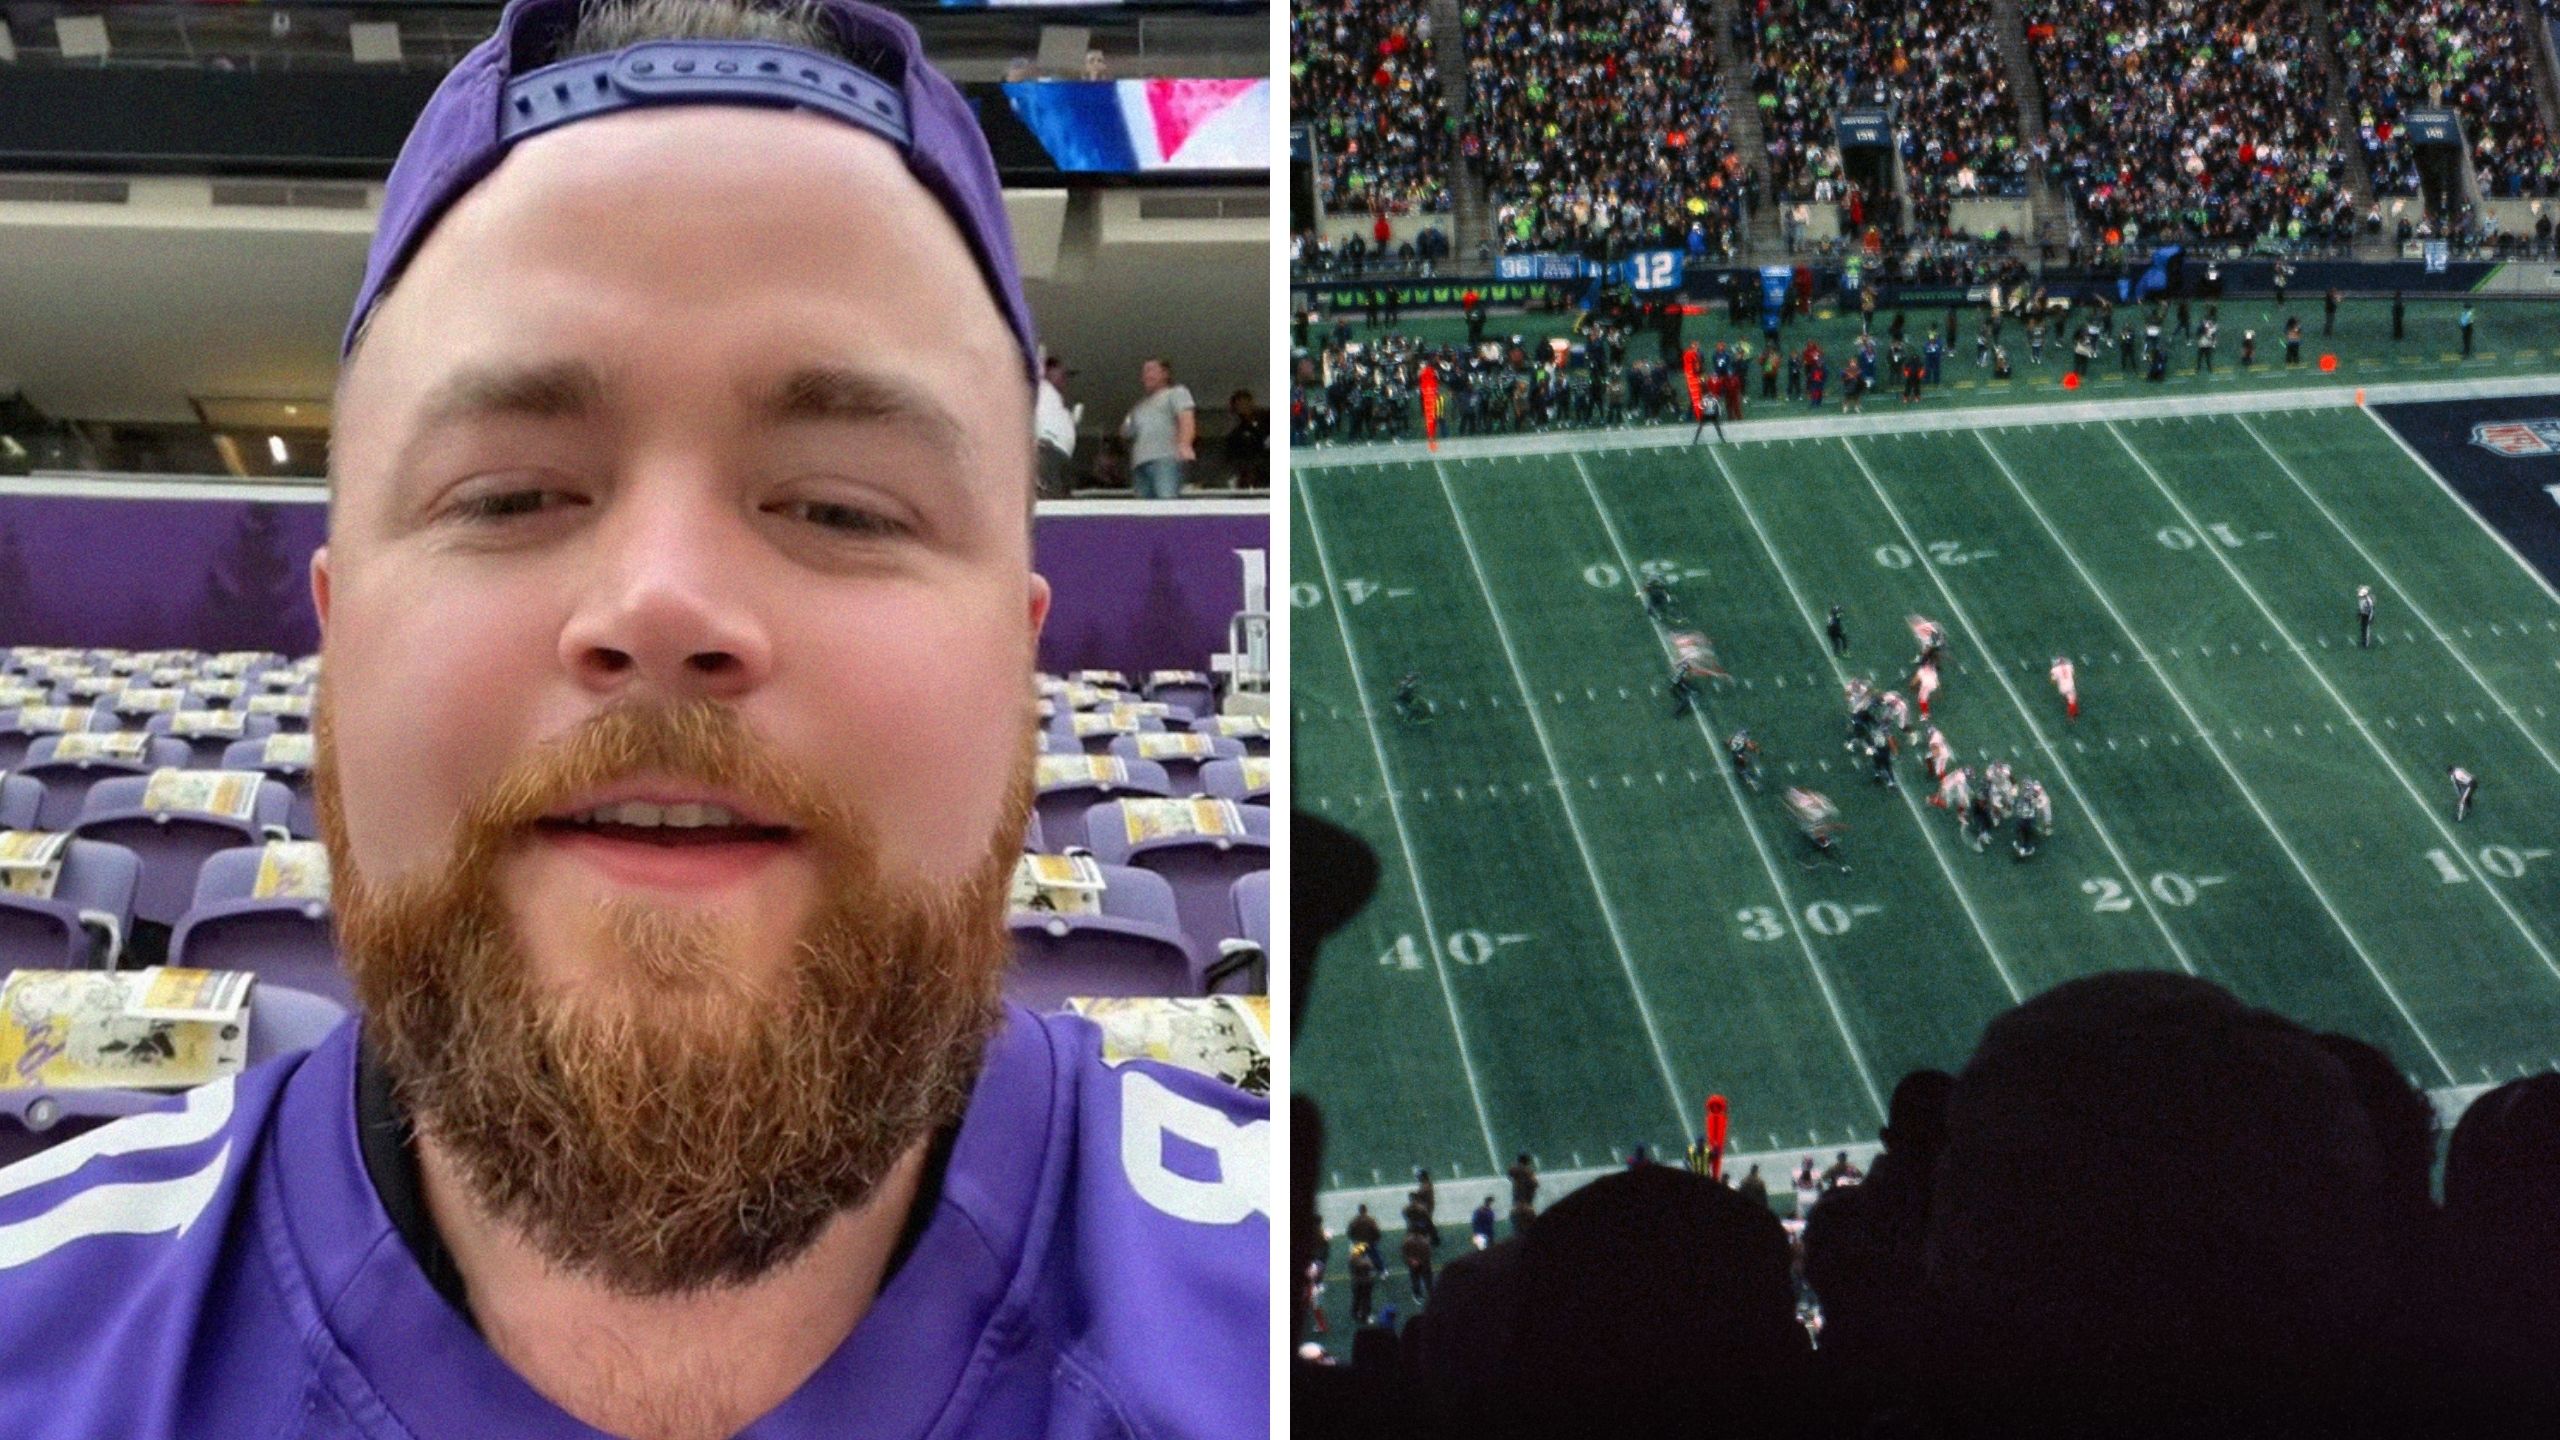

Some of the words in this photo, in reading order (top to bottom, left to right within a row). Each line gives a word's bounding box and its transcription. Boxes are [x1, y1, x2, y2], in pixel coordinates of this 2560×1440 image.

[1501, 257, 1531, 278] 96
[1634, 252, 1673, 290] 12
[2425, 845, 2526, 884] 10
[2081, 871, 2198, 912] 20
[1736, 901, 1852, 941] 30
[1379, 928, 1496, 970] 40
